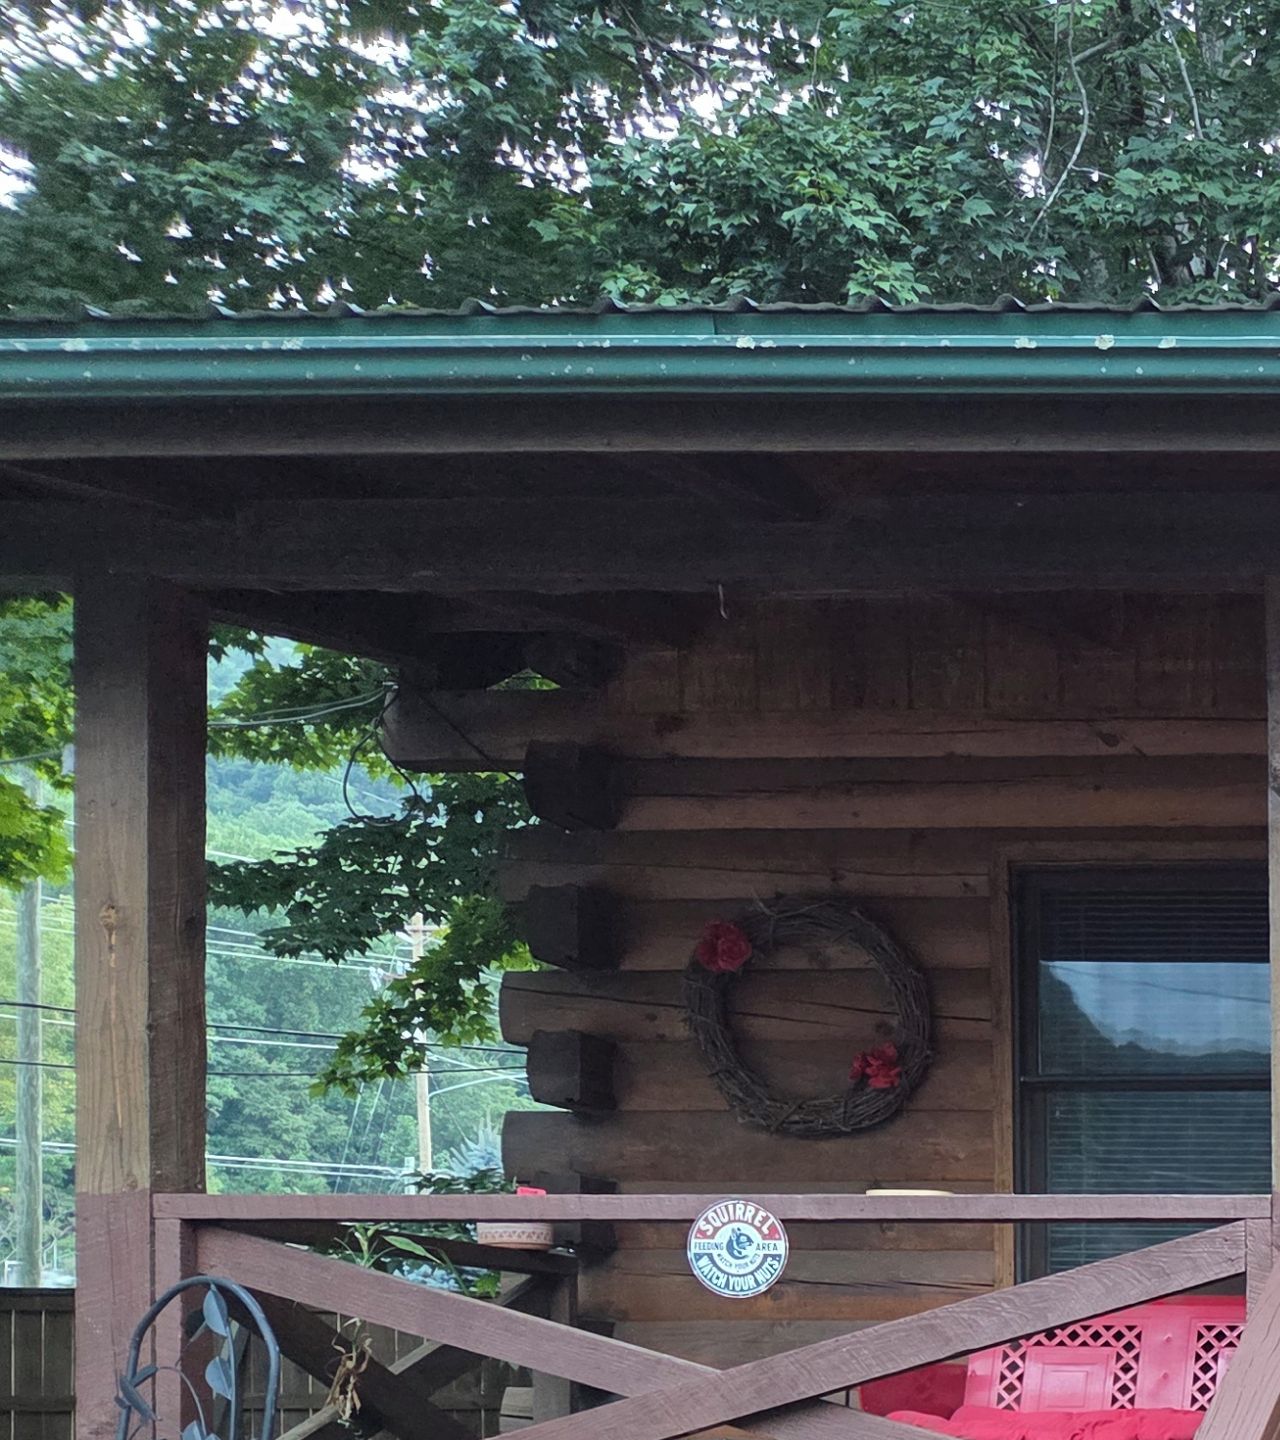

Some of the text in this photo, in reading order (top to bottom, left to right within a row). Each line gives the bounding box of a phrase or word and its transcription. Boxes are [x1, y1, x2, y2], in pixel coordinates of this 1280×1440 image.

[699, 1203, 774, 1236] SQUIRREL
[694, 1242, 778, 1251] FEEDING AREA
[698, 1256, 779, 1291] WATCH YOUR NUTS
